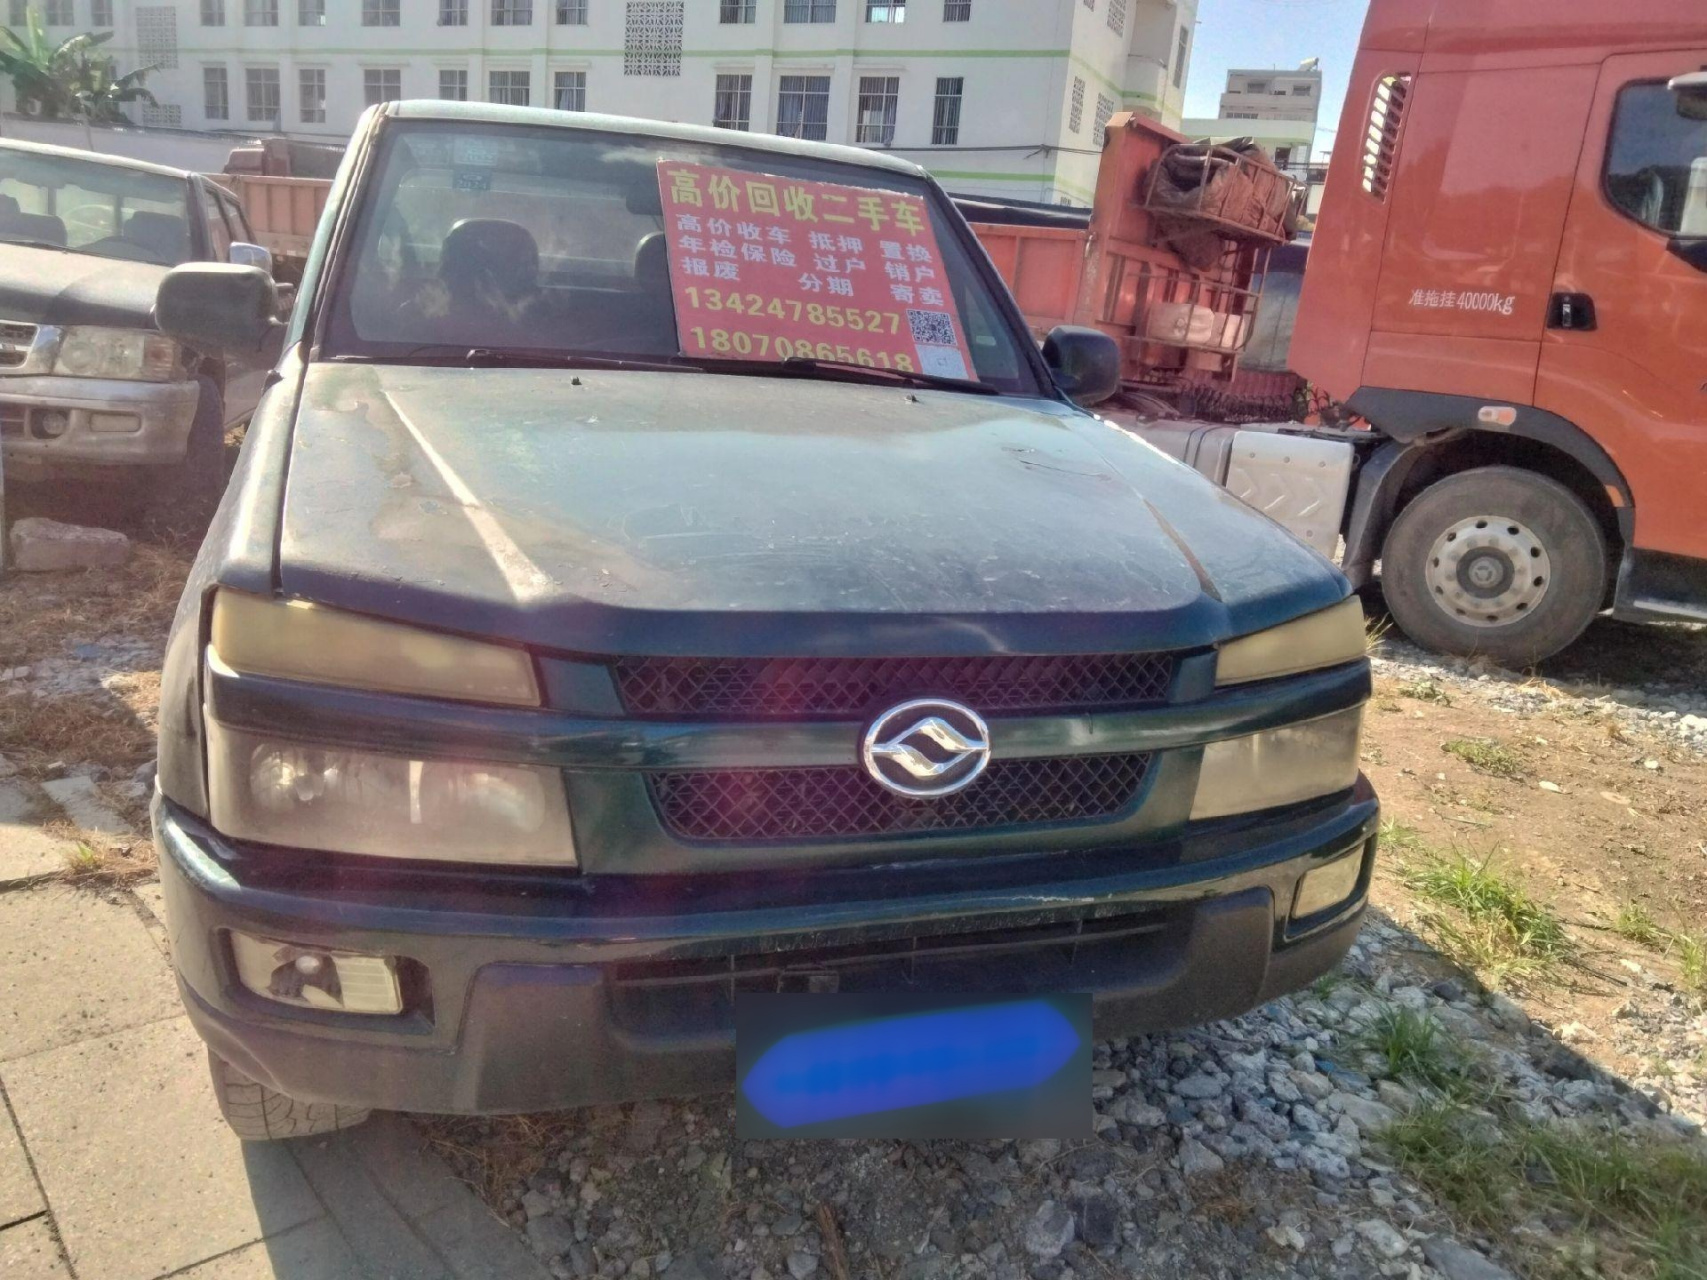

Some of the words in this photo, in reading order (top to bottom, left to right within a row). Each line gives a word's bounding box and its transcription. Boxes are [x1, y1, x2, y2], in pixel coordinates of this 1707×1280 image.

[668, 169, 924, 236] 高价回收二手车
[676, 213, 792, 245] 高价收车
[808, 230, 863, 254] 抵押
[880, 240, 932, 263] 置换
[678, 235, 796, 267] 年检保险
[814, 252, 866, 274] 过户
[885, 260, 934, 283] 销户
[680, 256, 740, 281] 报废
[798, 272, 854, 296] 分期
[685, 286, 900, 335] 13424785527
[690, 326, 914, 372] 18070865618
